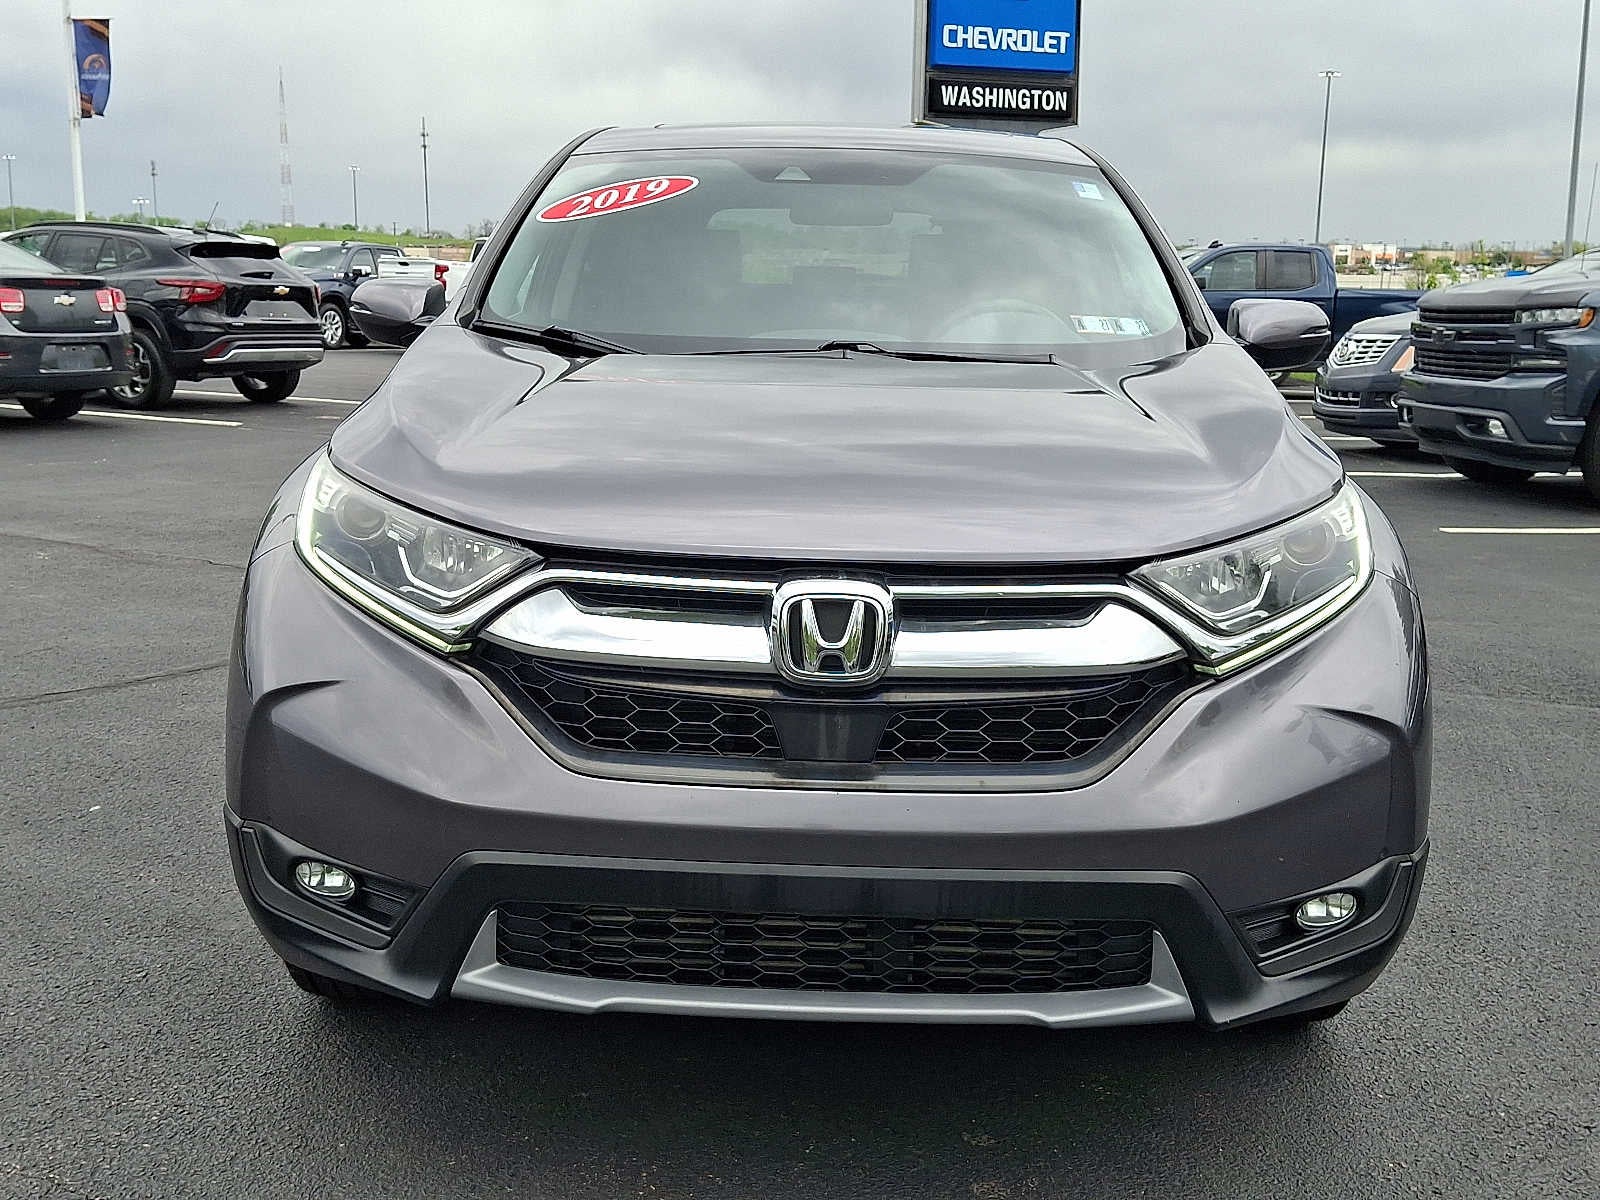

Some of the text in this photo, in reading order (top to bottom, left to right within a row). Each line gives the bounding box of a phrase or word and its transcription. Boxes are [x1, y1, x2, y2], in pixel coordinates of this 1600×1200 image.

[942, 24, 1071, 54] CHEVROLET
[941, 85, 1068, 112] WASHINGTON
[566, 178, 671, 218] 2019
